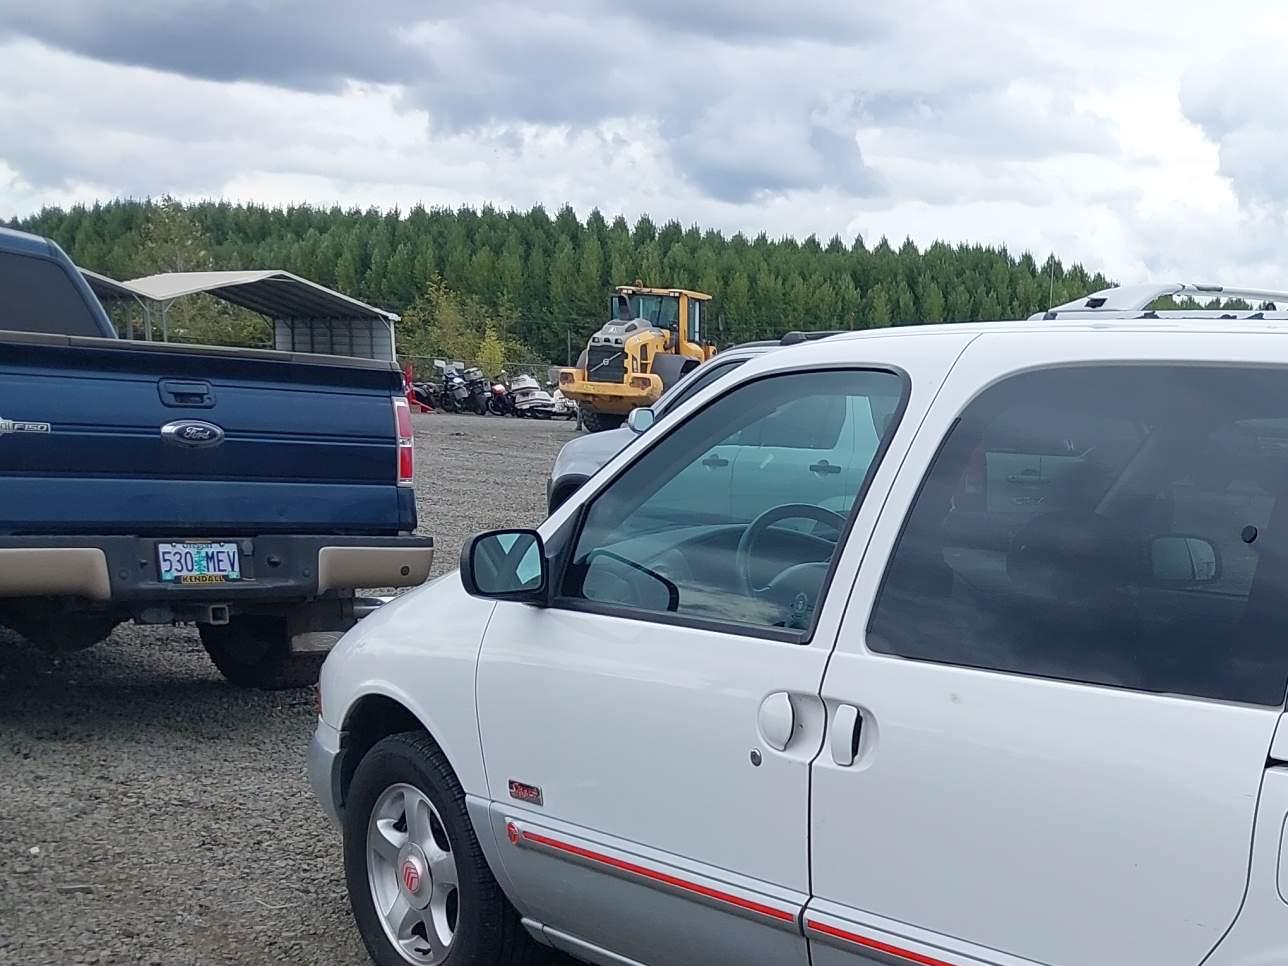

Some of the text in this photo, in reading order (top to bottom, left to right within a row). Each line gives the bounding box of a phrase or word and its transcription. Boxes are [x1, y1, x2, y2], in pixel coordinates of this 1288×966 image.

[184, 427, 211, 440] Ford
[162, 551, 237, 573] 530 MEV
